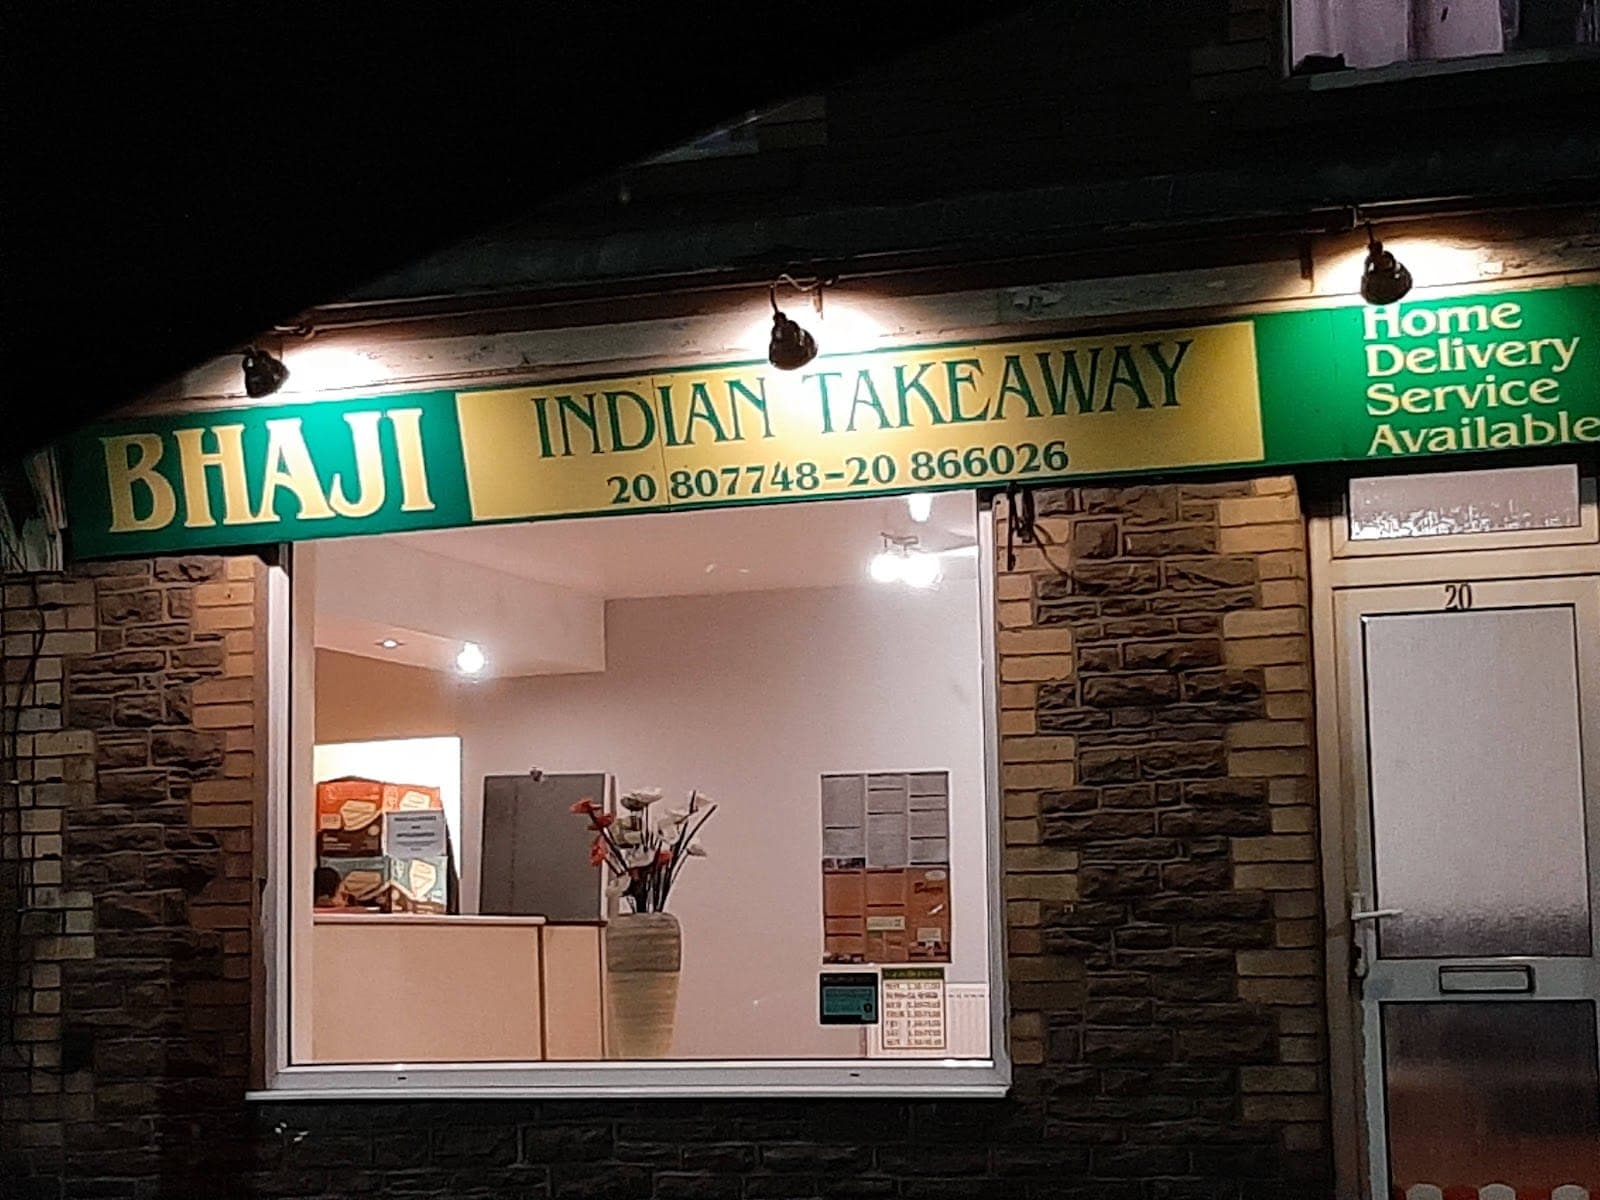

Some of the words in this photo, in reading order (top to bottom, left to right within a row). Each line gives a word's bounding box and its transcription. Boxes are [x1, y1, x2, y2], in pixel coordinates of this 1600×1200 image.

[1363, 301, 1523, 340] Home
[1364, 336, 1581, 378] Delivery
[530, 376, 776, 459] INDIAN
[801, 338, 1195, 434] TAKEAWAY
[1366, 374, 1560, 416] Service
[1366, 410, 1600, 457] Available
[99, 407, 436, 533] BHAJI
[607, 474, 657, 504] 20
[910, 440, 1069, 481] 866026
[1444, 583, 1473, 610] 20
